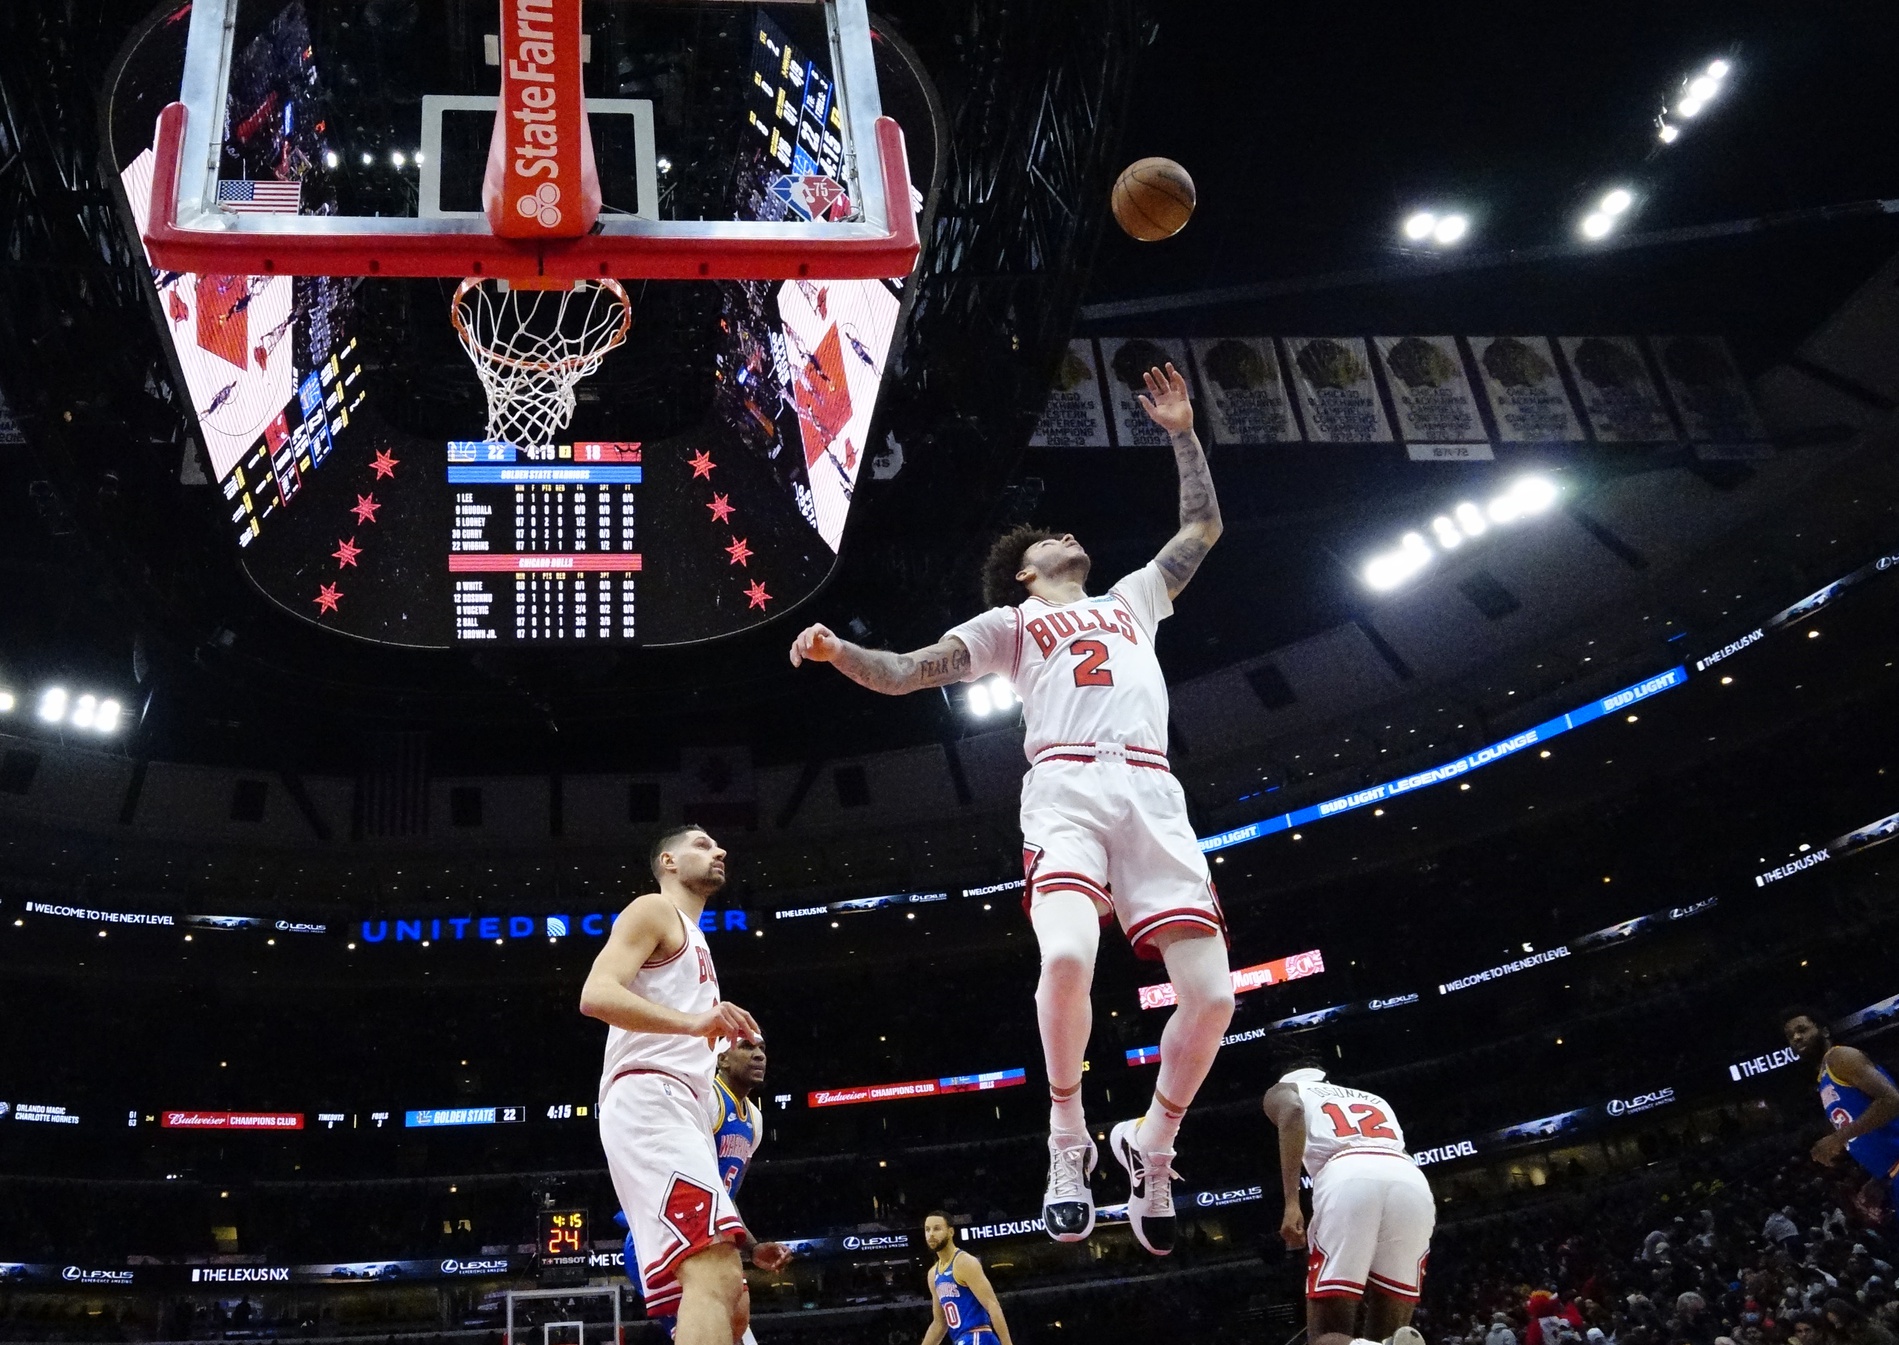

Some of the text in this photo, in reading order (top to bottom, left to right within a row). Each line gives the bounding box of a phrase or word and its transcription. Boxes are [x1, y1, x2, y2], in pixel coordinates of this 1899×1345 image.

[813, 181, 829, 198] 75
[487, 444, 505, 460] 22
[461, 493, 473, 503] LEE
[461, 529, 483, 539] CURRY
[461, 541, 490, 551] WIGGINS
[1025, 608, 1138, 661] BULLS
[1704, 628, 1764, 667] THE LEXUS NX
[1069, 639, 1114, 688] 2
[1603, 672, 1676, 711] BUD LIGHT
[1388, 731, 1539, 795] LEGENDS LOUNGE
[1320, 787, 1385, 816] BUD LIGHT
[1222, 826, 1258, 845] LIGHT
[1763, 848, 1831, 884] THE LEXUS NX
[968, 885, 1004, 898] WELCOME
[1003, 883, 1014, 892] TO
[34, 902, 175, 927] WELCOME TO THE NEXT LEVEL
[782, 909, 794, 918] THE
[794, 907, 817, 917] LEXUS
[290, 922, 326, 931] LEXUS
[362, 909, 749, 943] UNITED CER
[1446, 945, 1571, 993] WELCOME TO THE NEXT LEVEL
[1382, 993, 1419, 1007] LEXUS
[1225, 1032, 1249, 1047] LEXUS
[1247, 1028, 1266, 1042] NX
[1739, 1056, 1769, 1078] THE
[815, 1083, 935, 1104] Budweiser CHAMPIONS CLUB
[1625, 1086, 1674, 1110] LEXUS
[16, 1103, 66, 1116] ORLANDO MAGIC
[318, 1113, 345, 1122] TIMEOUTS
[371, 1112, 389, 1121] FOULS
[434, 1108, 496, 1124] GOLDEN STATE
[503, 1109, 516, 1122] 22
[547, 1105, 572, 1120] 4:15
[15, 1112, 80, 1125] CHARLOTTE HORNETS
[168, 1112, 297, 1127] Budweiser CHAMPIONS CLUB
[1321, 1102, 1398, 1141] 12
[1440, 1140, 1478, 1162] LEVEL
[1214, 1186, 1263, 1202] LEXUS
[552, 1213, 583, 1229] 4:15
[970, 1225, 993, 1240] THE
[993, 1219, 1031, 1238] LEXUS
[548, 1229, 579, 1254] 24
[861, 1235, 908, 1246] LEXUS
[459, 1260, 508, 1270] LEXUS
[552, 1256, 586, 1266] TISSOT
[83, 1270, 134, 1279] LEXUS
[203, 1266, 290, 1283] THE LEXUS NX
[942, 1300, 962, 1330] 0
